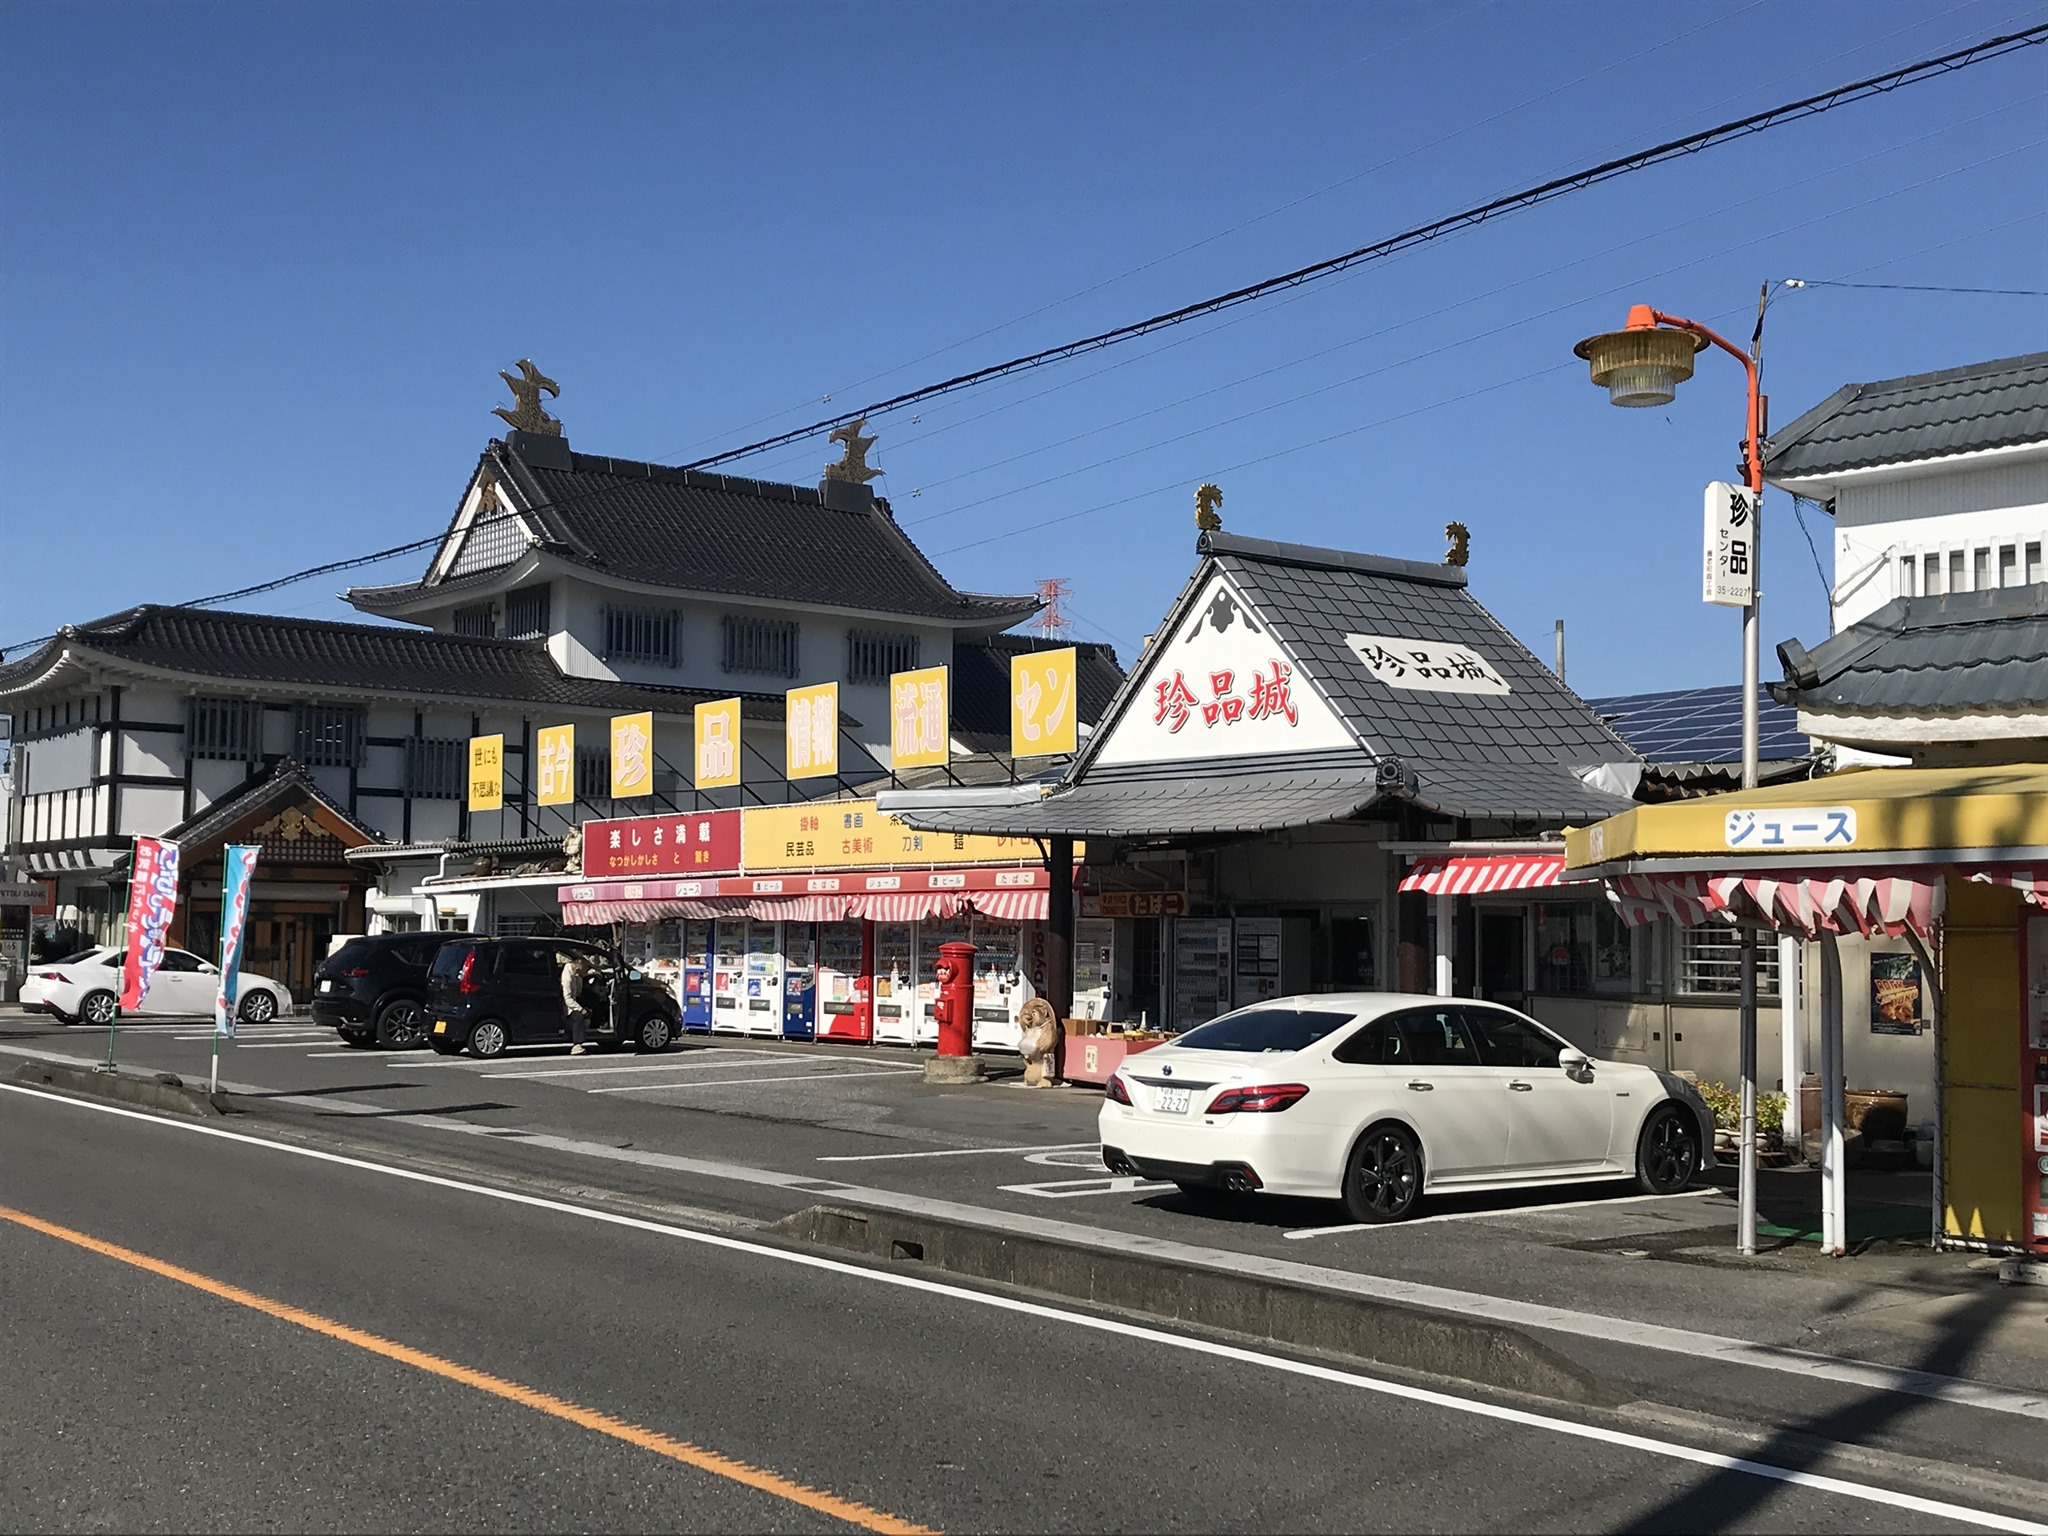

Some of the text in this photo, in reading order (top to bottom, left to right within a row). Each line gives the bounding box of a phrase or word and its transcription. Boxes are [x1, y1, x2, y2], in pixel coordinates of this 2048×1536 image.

[1730, 493, 1748, 575] 珍品
[1719, 528, 1729, 577] センター
[1717, 585, 1748, 597] 35-2227
[1360, 643, 1502, 686] 珍品城
[1015, 667, 1072, 741] セン
[1152, 657, 1298, 734] 珍品城
[789, 694, 835, 769] 情報
[895, 678, 945, 760] 流通
[474, 746, 498, 767] 世にも
[614, 722, 648, 787] 珍
[699, 709, 734, 780] 品
[540, 734, 572, 797] 古今
[472, 780, 500, 798] 不思議な
[609, 821, 711, 849] 楽しさ満載
[800, 815, 819, 832] 掛軸
[843, 812, 864, 829] 書画
[1729, 811, 1853, 846] ジュース
[673, 852, 680, 865] と
[786, 840, 815, 857] 民芸品
[842, 837, 873, 854] 古美術
[902, 835, 923, 852] 刀剣
[677, 884, 700, 895] ジュース
[811, 880, 836, 889] たばこ
[869, 878, 897, 888] ジュース
[1000, 874, 1029, 884] たばこ
[24, 889, 46, 898] BANK
[1134, 894, 1179, 915] たばこ
[1034, 932, 1047, 984] DyDo
